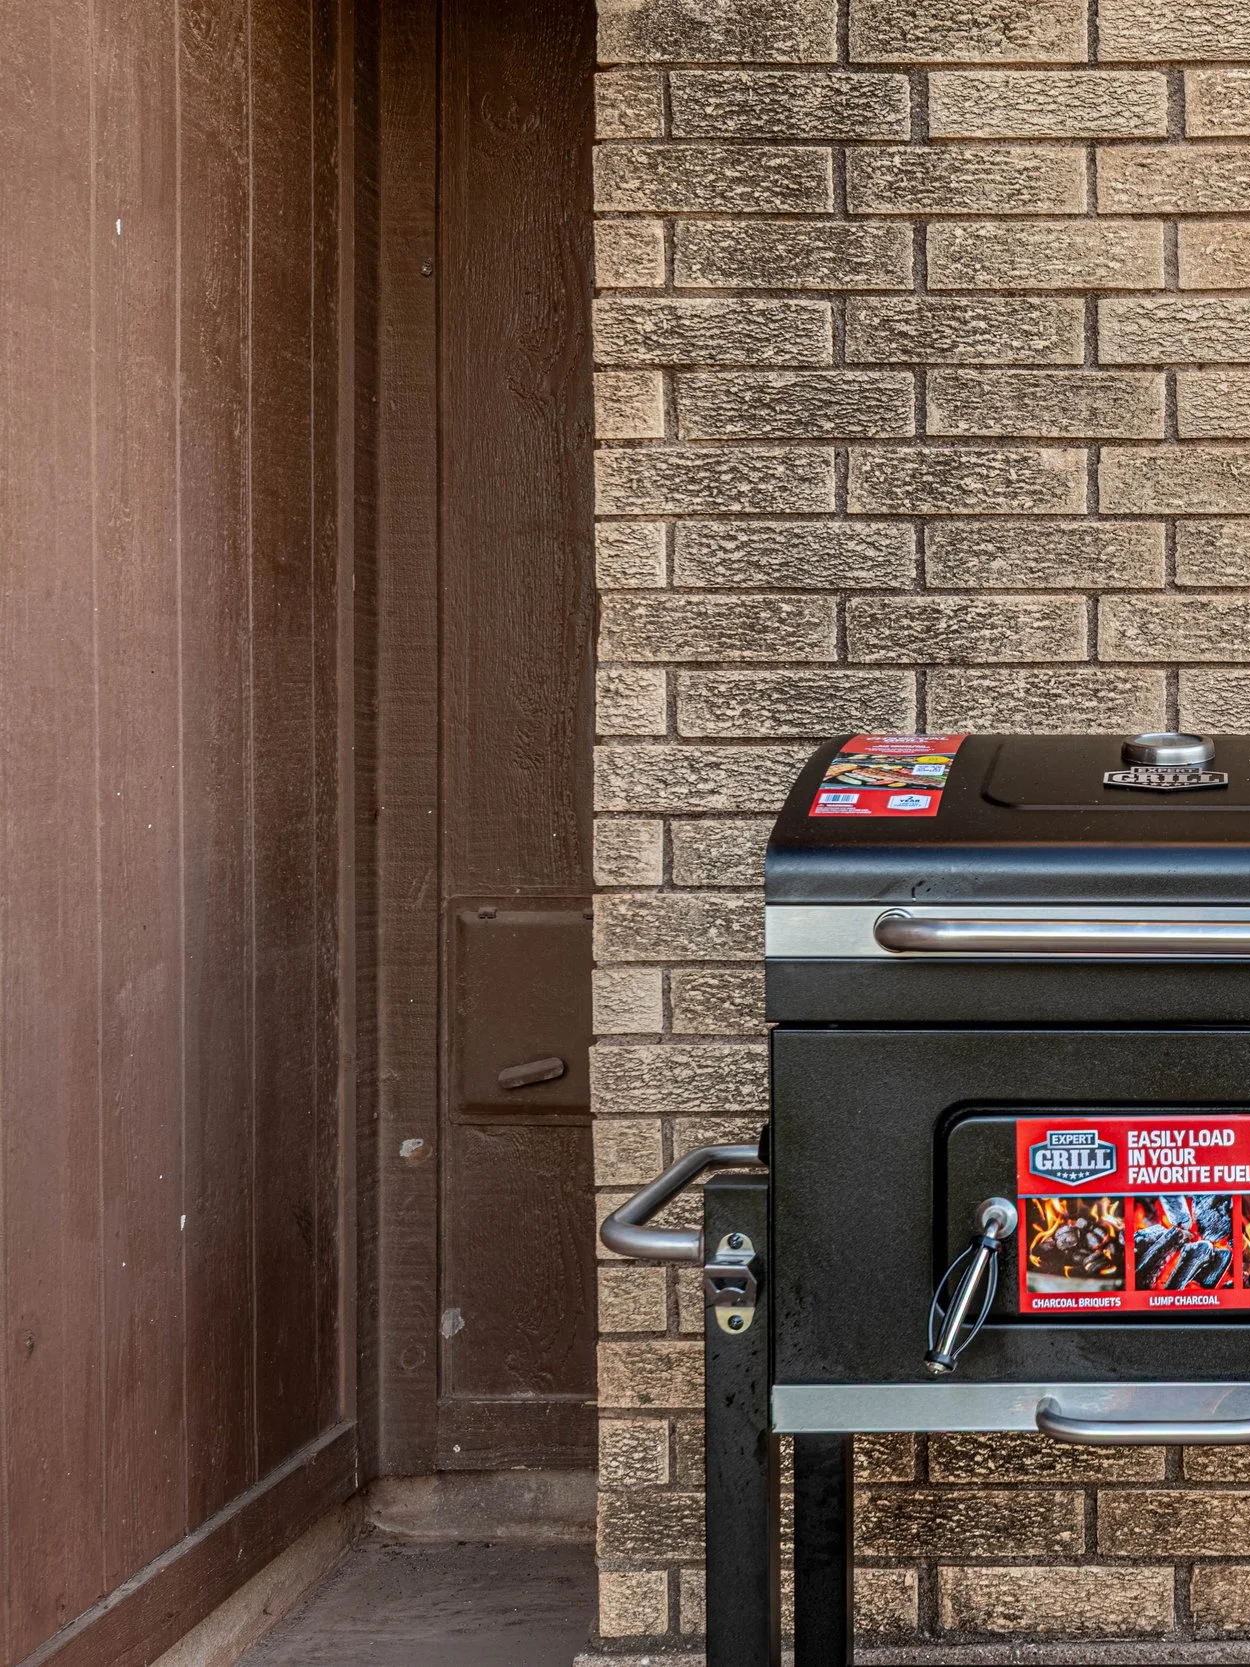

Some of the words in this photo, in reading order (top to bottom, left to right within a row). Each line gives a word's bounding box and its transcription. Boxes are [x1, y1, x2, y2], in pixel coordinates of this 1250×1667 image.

[1112, 773, 1220, 783] GRILL
[1051, 1134, 1093, 1145] EXPERT
[1127, 1130, 1186, 1148] EASILY
[1188, 1129, 1235, 1147] LOAD
[1035, 1149, 1111, 1171] GRILL
[1127, 1149, 1146, 1166] IN
[1147, 1148, 1197, 1166] YOUR
[1128, 1166, 1211, 1185] FAVORITE
[1032, 1298, 1078, 1309] CHARCOAL
[1079, 1297, 1121, 1308] BRIQUETS
[1149, 1296, 1174, 1306] LUMP
[1174, 1295, 1220, 1305] CHARCOAL
